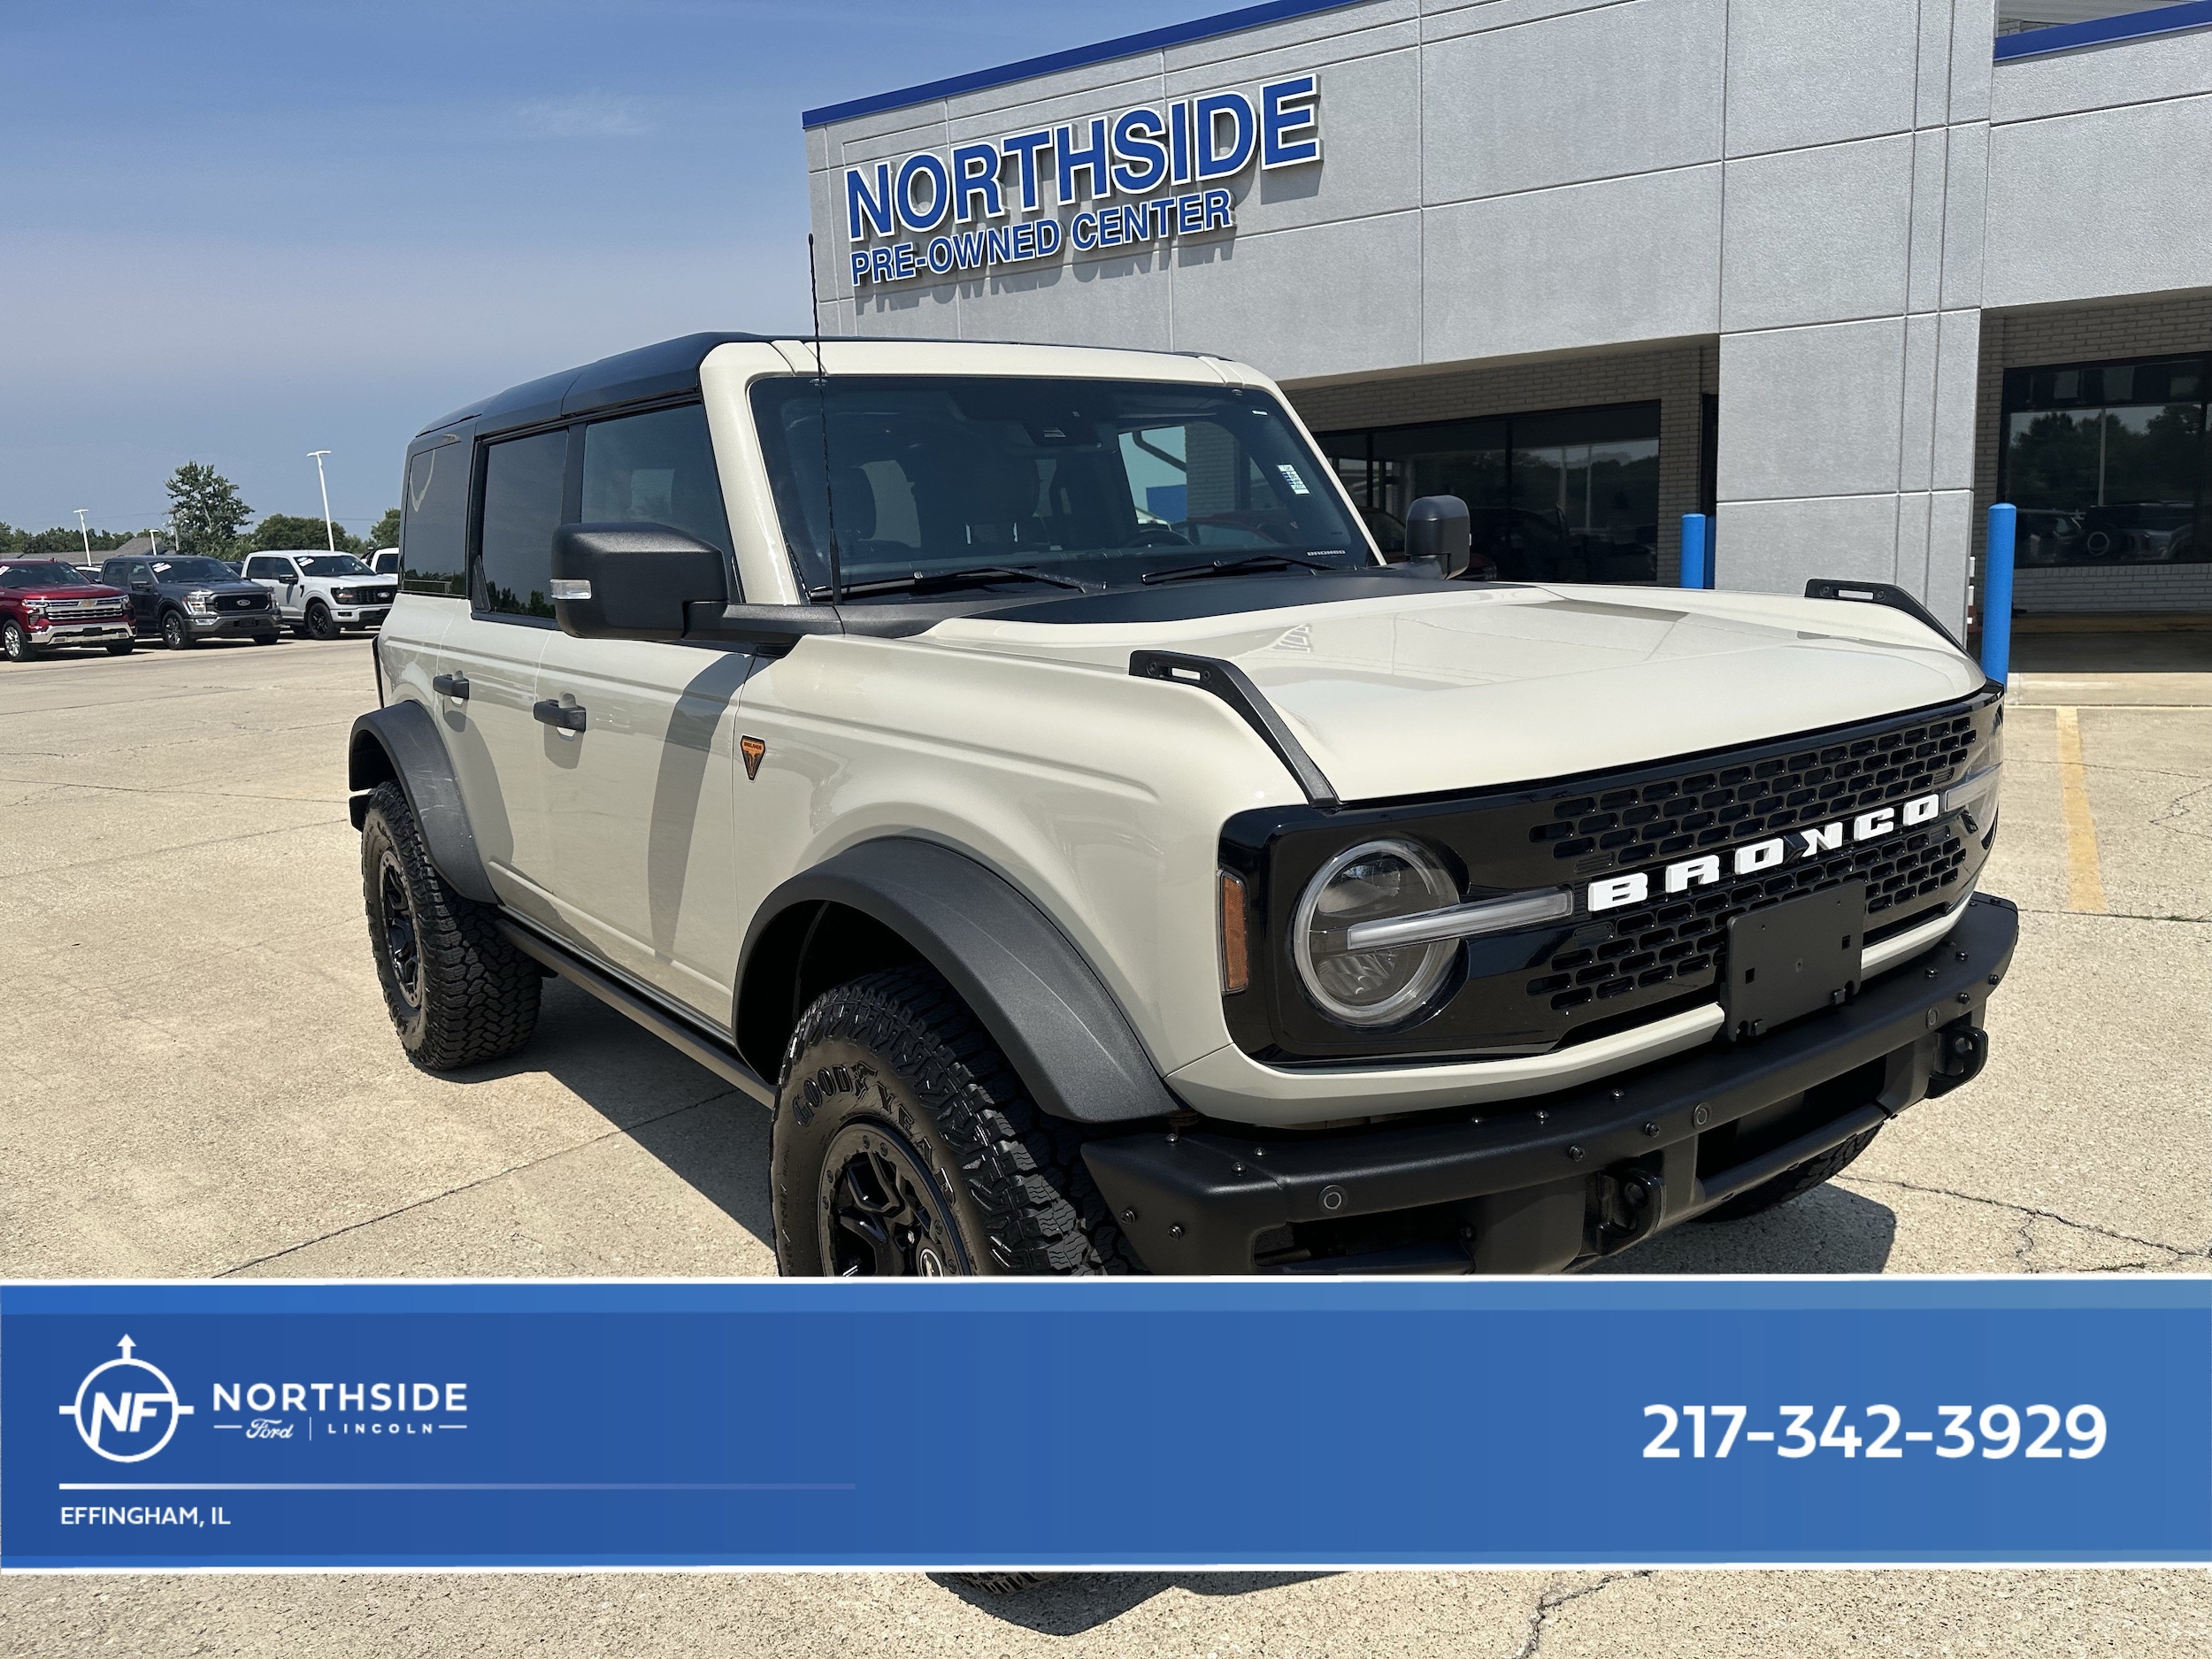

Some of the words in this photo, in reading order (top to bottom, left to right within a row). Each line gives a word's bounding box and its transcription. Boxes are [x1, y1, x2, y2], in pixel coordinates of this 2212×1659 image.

[844, 73, 1323, 242] NORTHSIDE
[850, 218, 1061, 286] PRE-OWNED
[1071, 188, 1233, 251] CENTER
[1587, 794, 1939, 912] BRONCO
